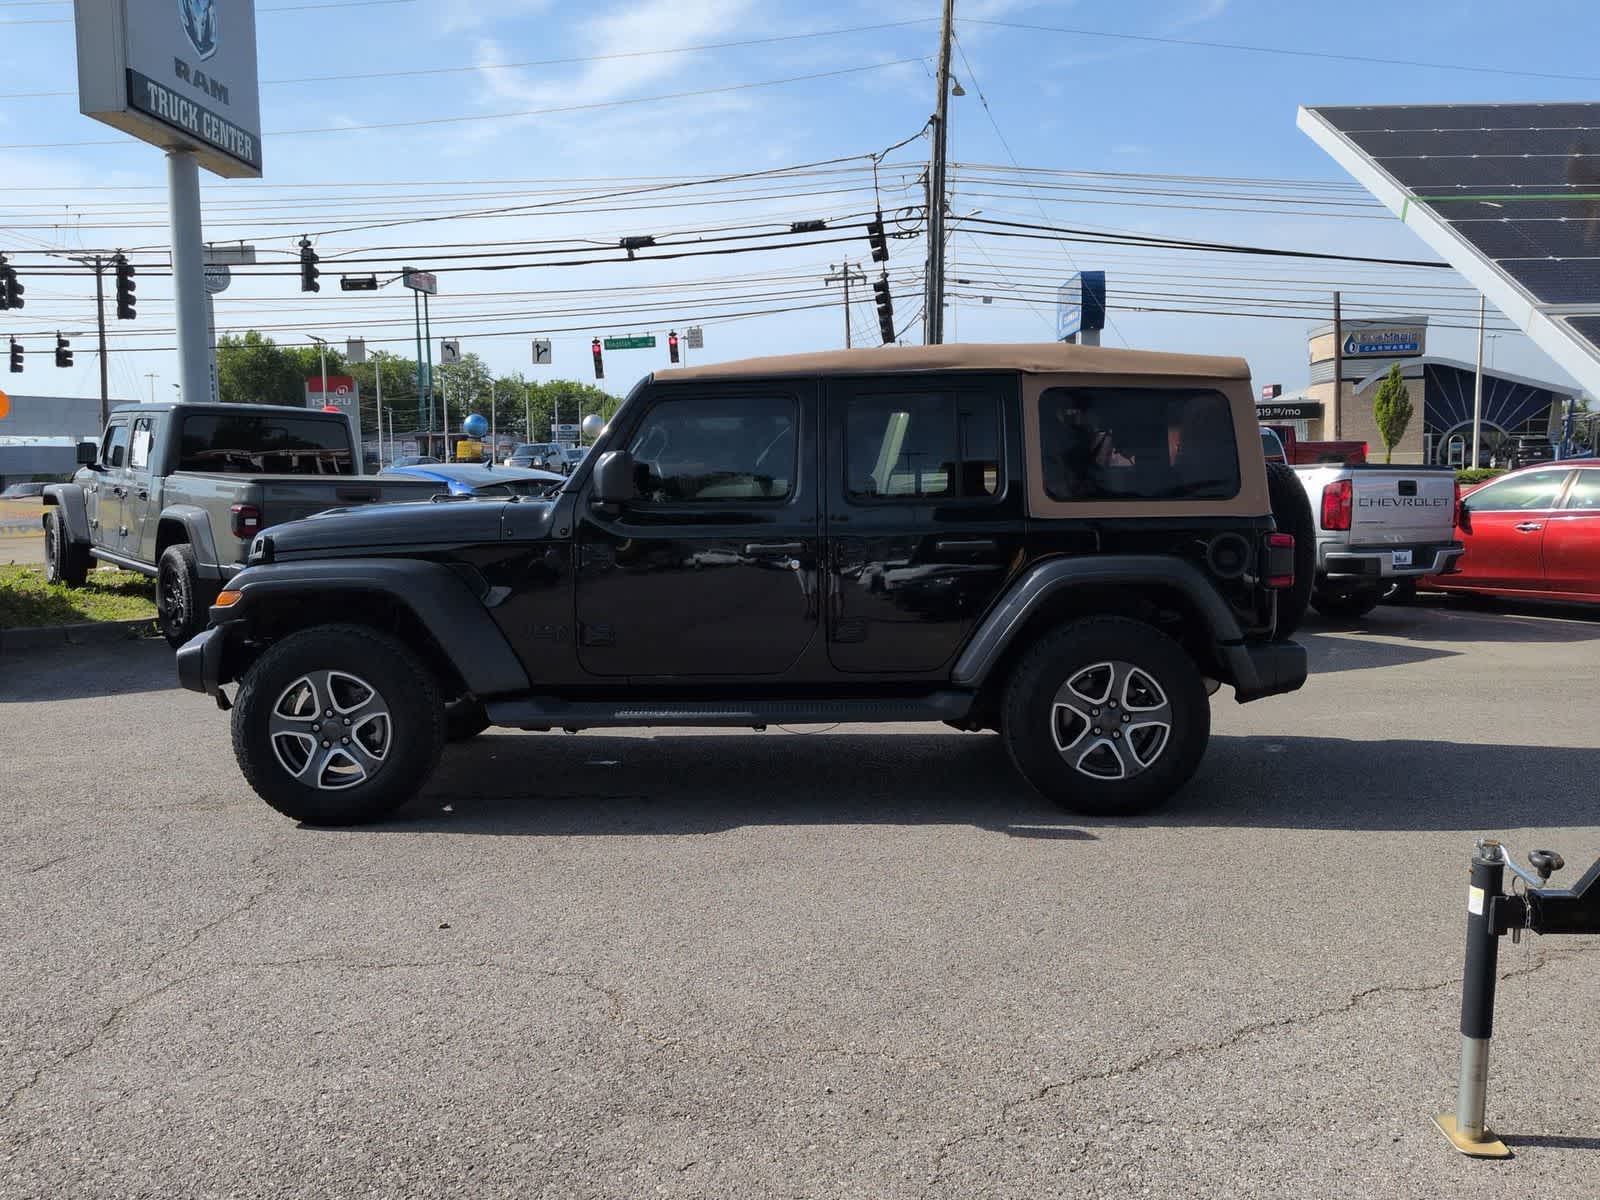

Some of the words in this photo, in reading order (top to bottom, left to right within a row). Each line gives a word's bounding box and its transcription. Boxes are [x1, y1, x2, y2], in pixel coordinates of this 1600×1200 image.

[174, 56, 230, 105] RAM
[147, 81, 199, 132] TRUCK
[203, 112, 253, 161] CENTER
[1358, 497, 1449, 507] CHEVROLET
